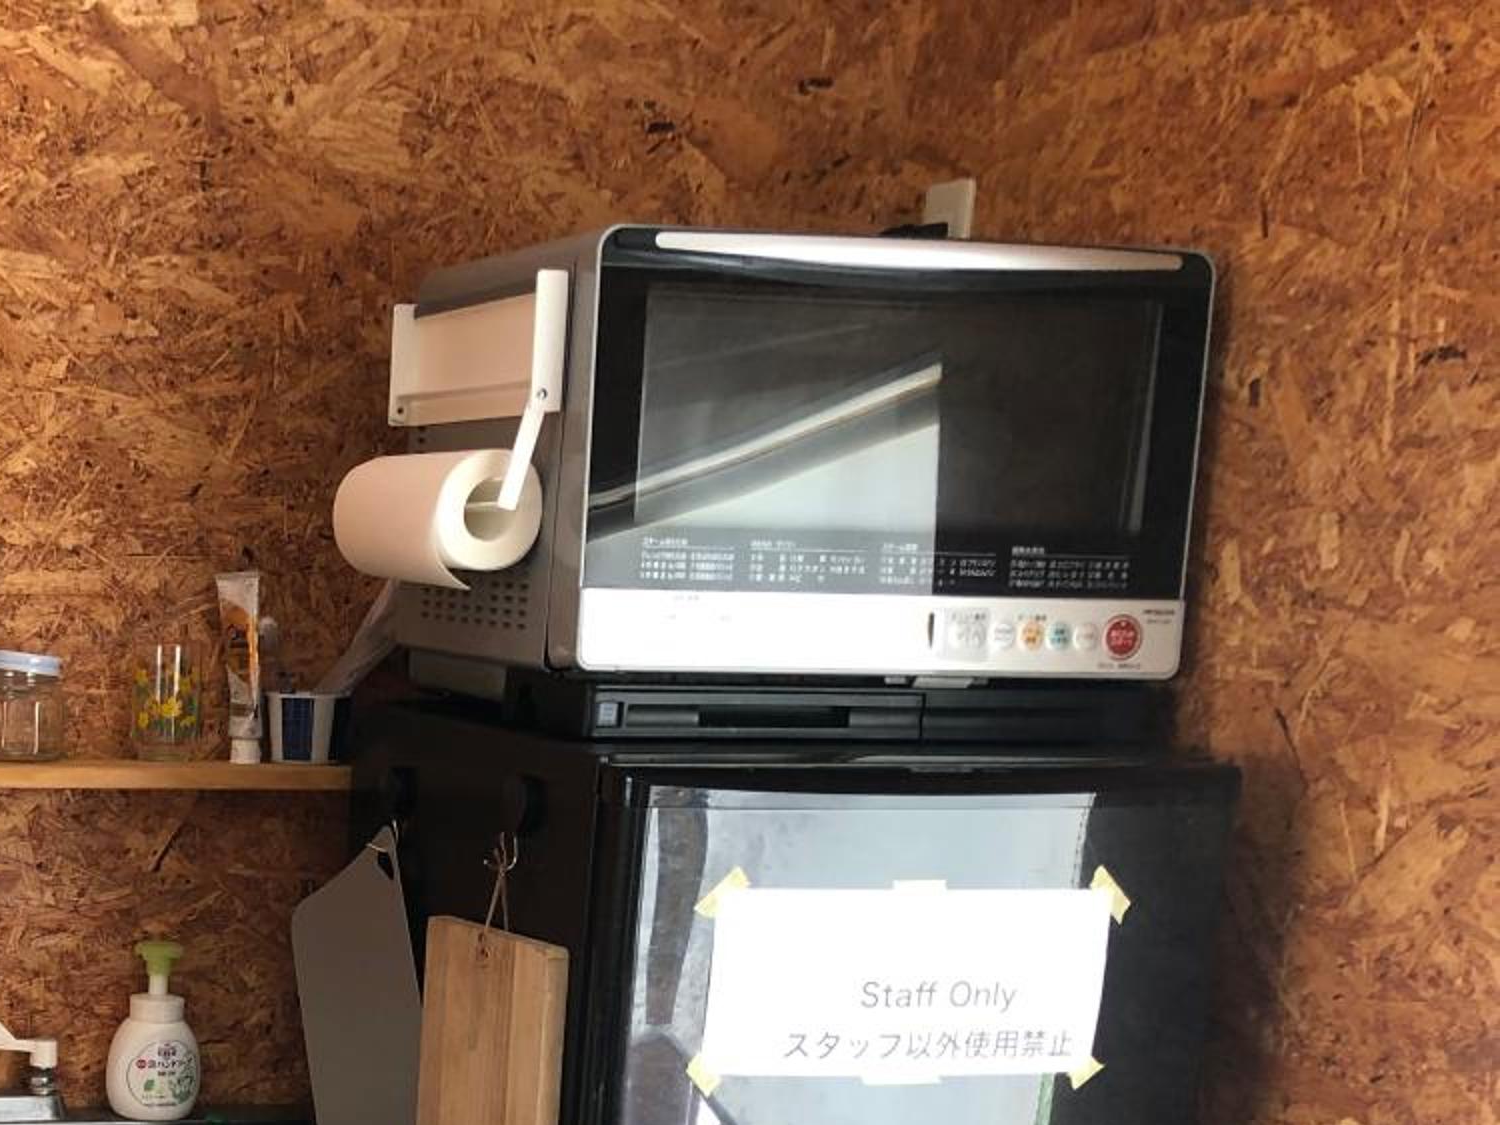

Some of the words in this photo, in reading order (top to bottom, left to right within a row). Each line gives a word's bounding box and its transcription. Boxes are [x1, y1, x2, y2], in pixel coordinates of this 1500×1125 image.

[860, 980, 939, 1009] Staff
[949, 979, 1018, 1014] Only
[783, 1030, 1073, 1059] スタッフ以外使用禁止
